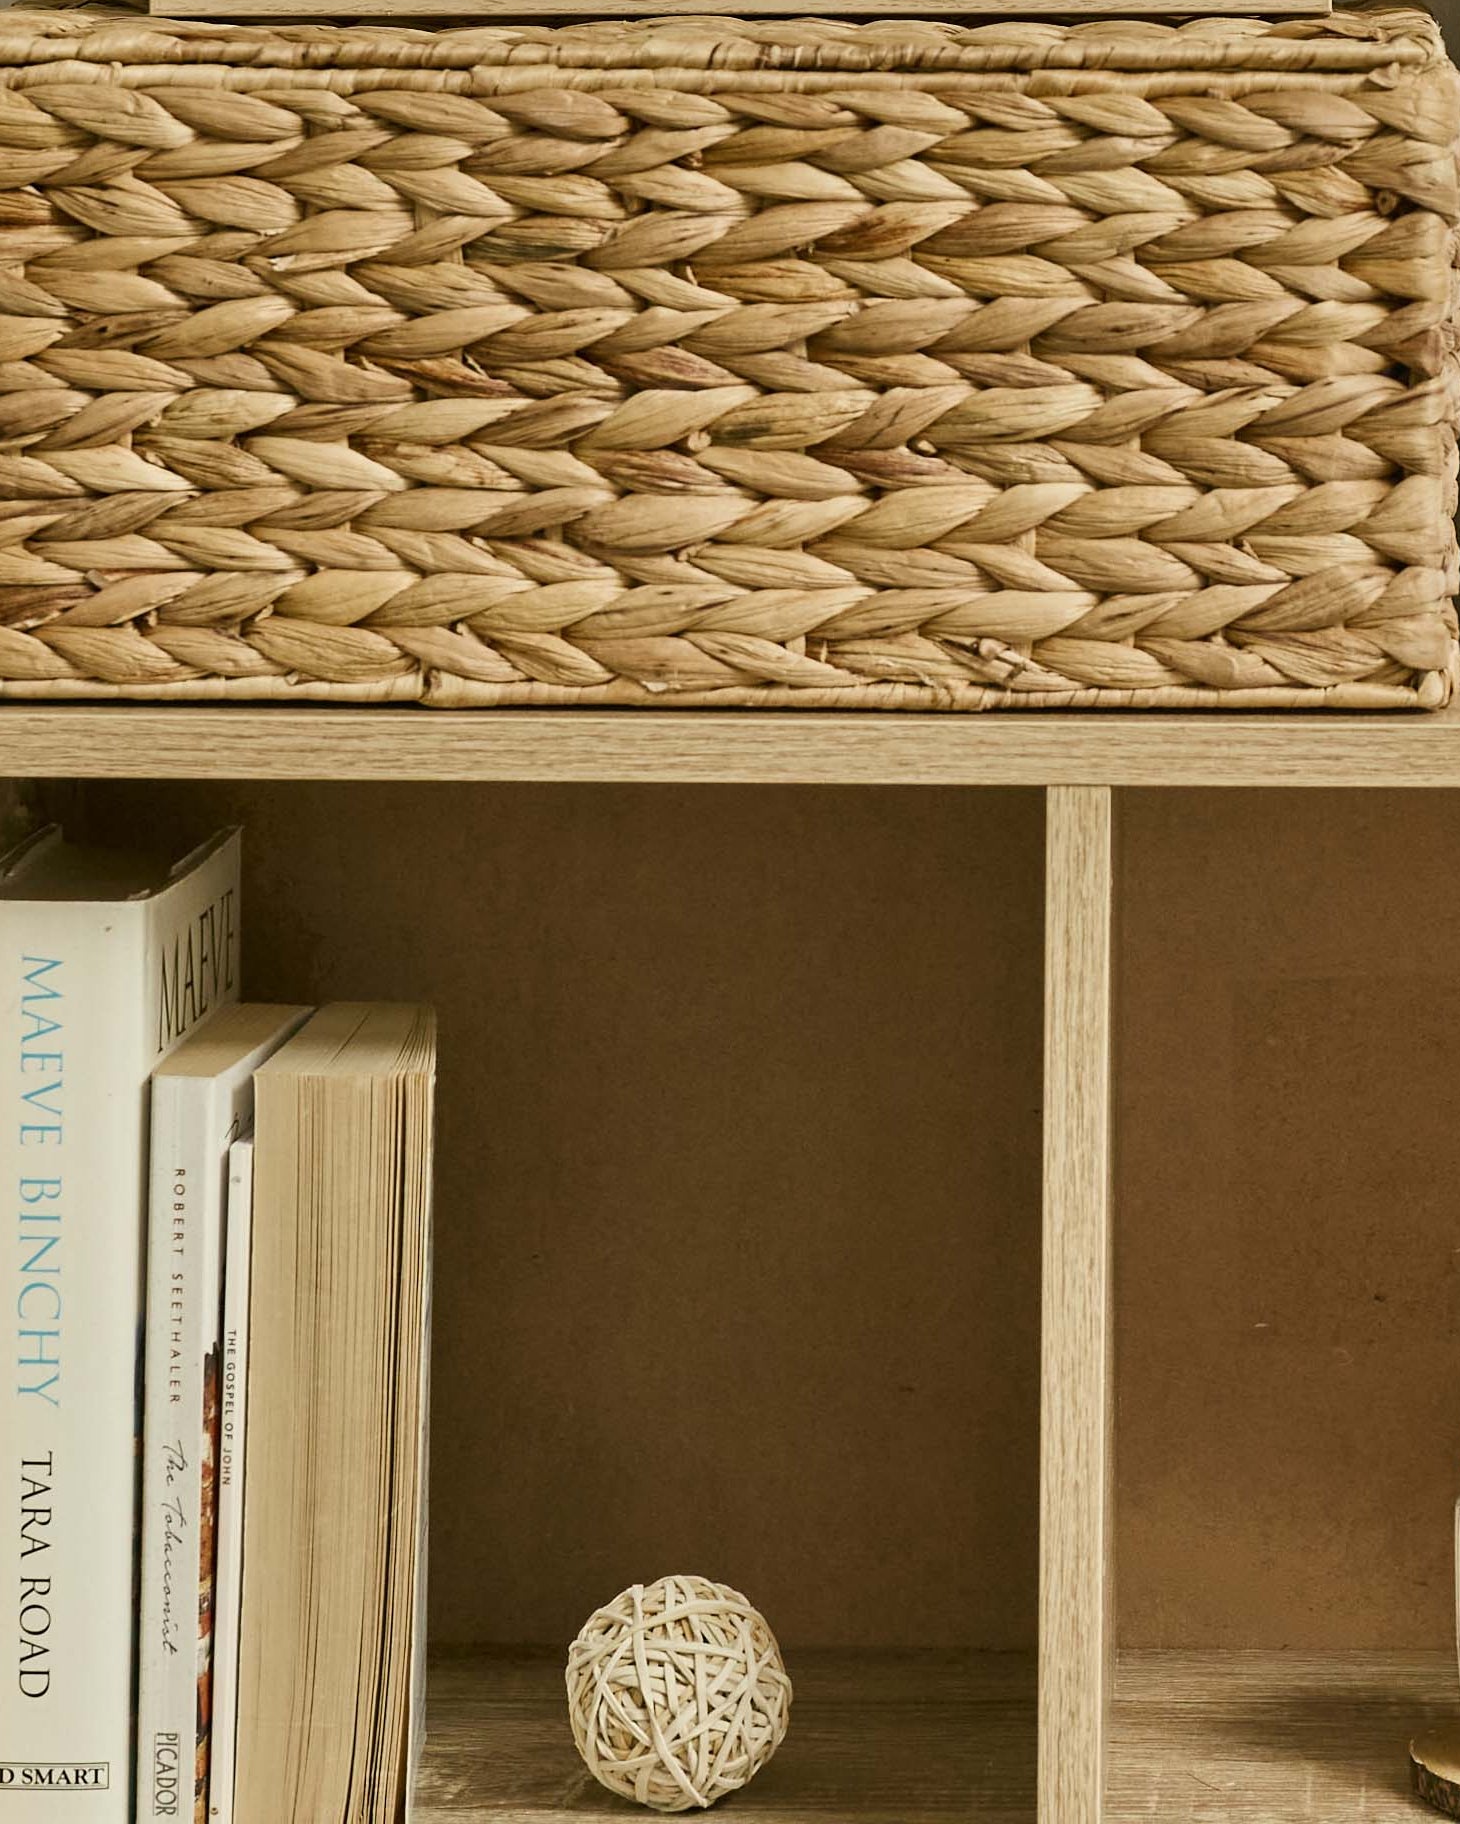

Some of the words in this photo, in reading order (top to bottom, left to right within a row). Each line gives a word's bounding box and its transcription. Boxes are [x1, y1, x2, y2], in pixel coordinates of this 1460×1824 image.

[157, 887, 234, 1055] MAEVE
[19, 953, 64, 1146] MAEVE
[172, 1168, 186, 1256] ROBERT
[17, 1175, 63, 1408] BINCHY
[169, 1273, 184, 1403] SEETHALER
[226, 1329, 237, 1355] THE
[223, 1422, 234, 1441] OF
[224, 1361, 236, 1416] GOSPEL
[20, 1450, 53, 1560] TARA
[162, 1439, 188, 1488] The
[221, 1450, 232, 1486] JOHN
[161, 1495, 187, 1657] Tobacconist
[18, 1577, 52, 1699] ROAD
[21, 1767, 105, 1785] SMART
[154, 1731, 179, 1817] PICADOR
